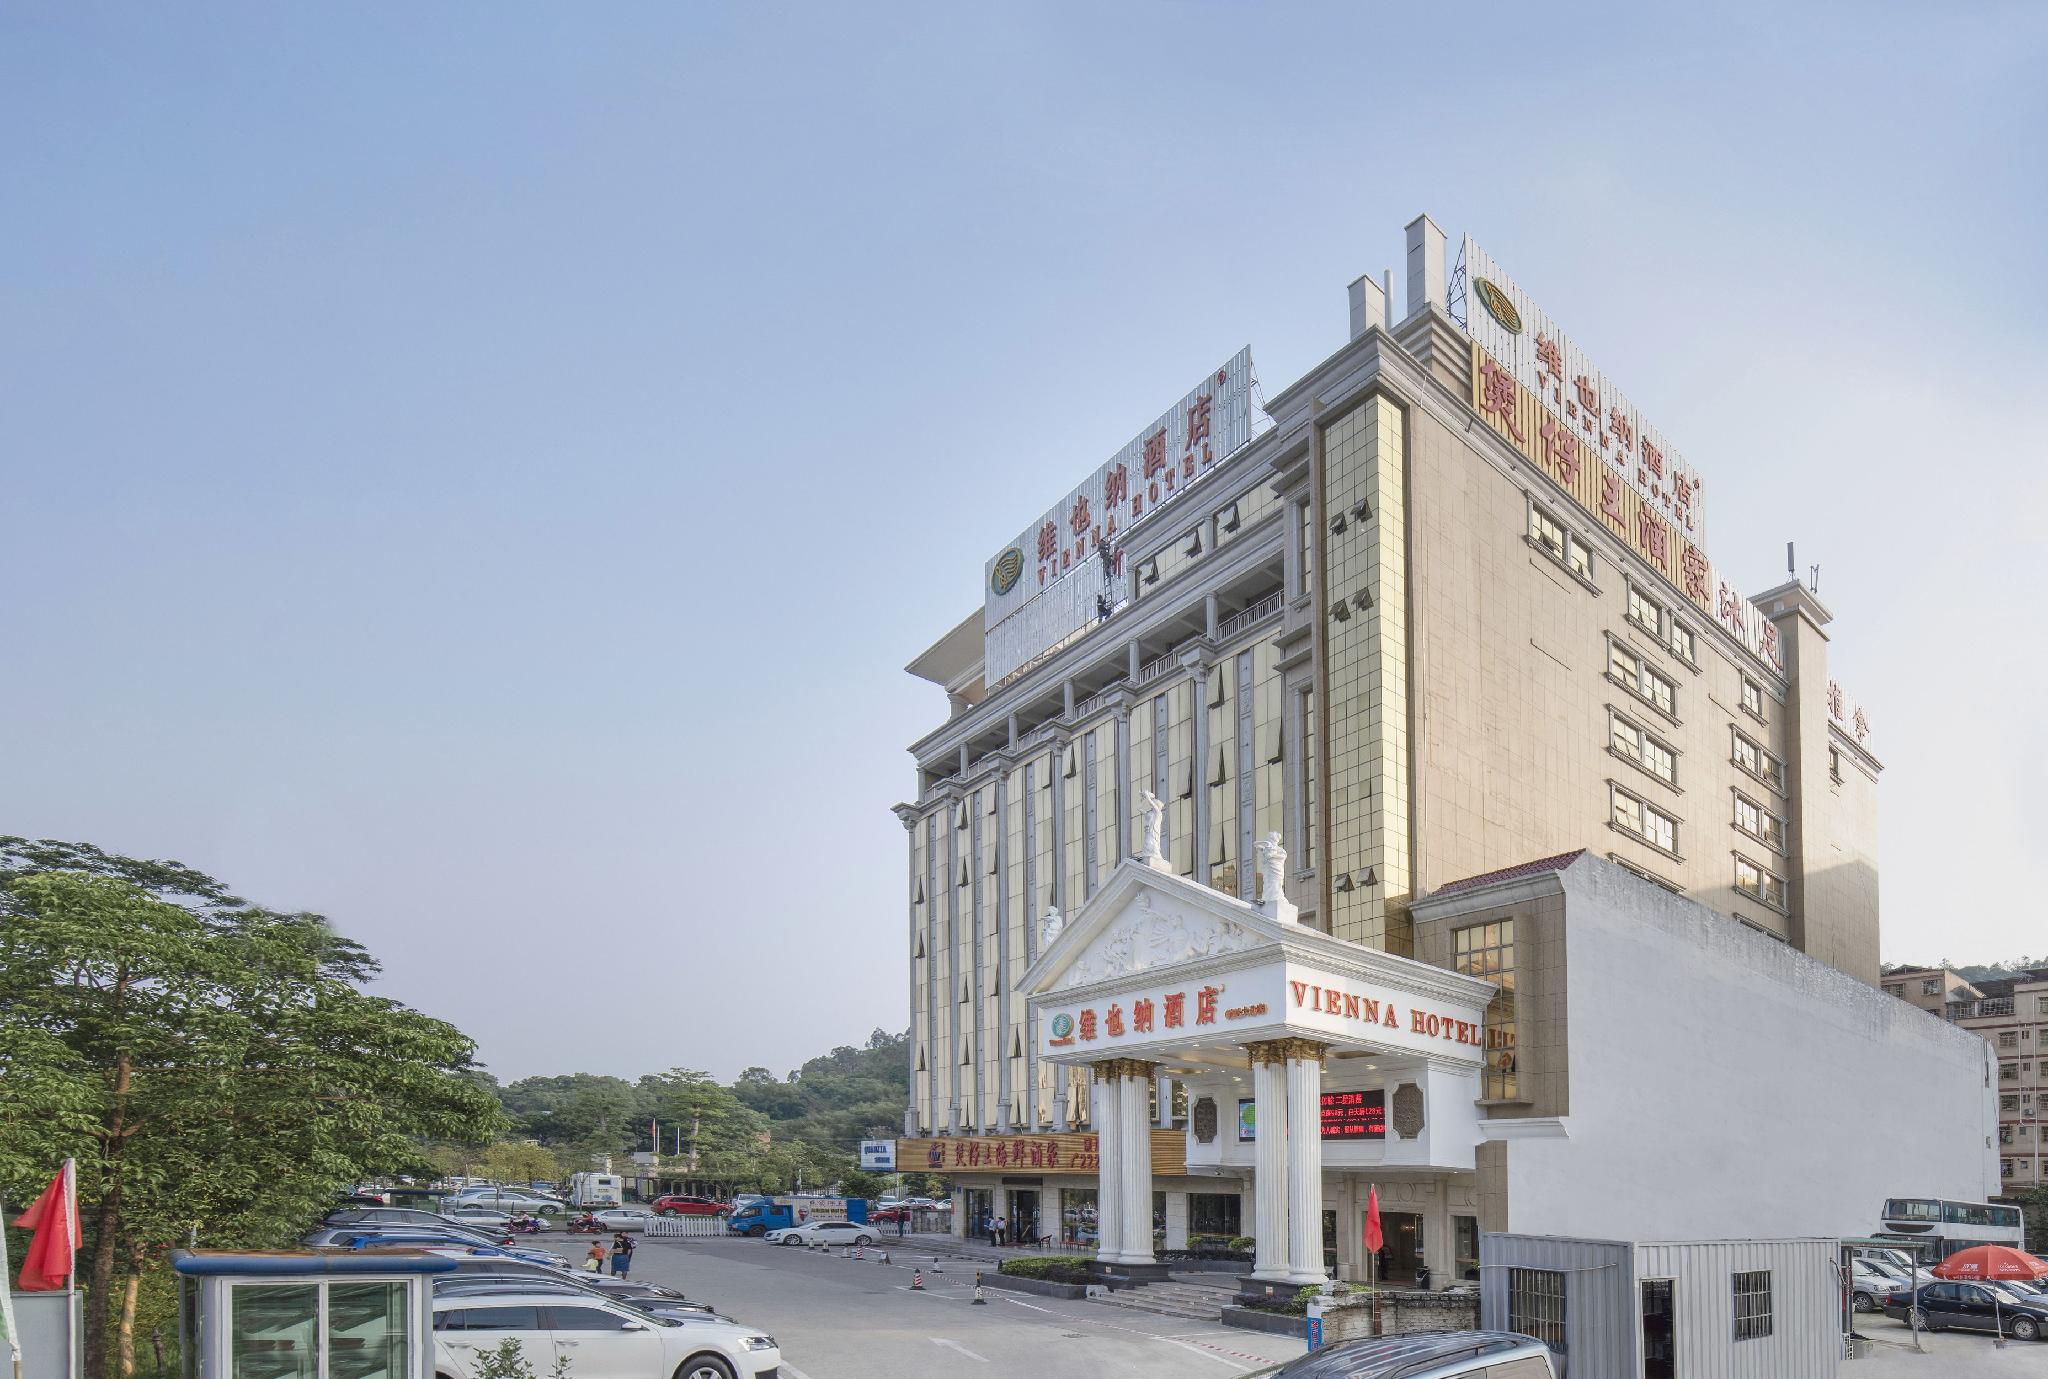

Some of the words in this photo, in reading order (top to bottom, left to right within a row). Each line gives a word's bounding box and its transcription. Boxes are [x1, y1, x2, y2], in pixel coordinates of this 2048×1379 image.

[1037, 393, 1213, 563] 维也纳酒店
[1536, 331, 1694, 510] 维也纳酒店
[1537, 370, 1626, 467] VIENNA
[1638, 467, 1694, 532] HOTEL
[1037, 514, 1118, 586] VIENNA
[1131, 441, 1213, 518] HOTEL
[1079, 984, 1221, 1042] 维也纳酒店
[1290, 980, 1400, 1029] VIENNA
[1410, 1008, 1482, 1047] HOTEL
